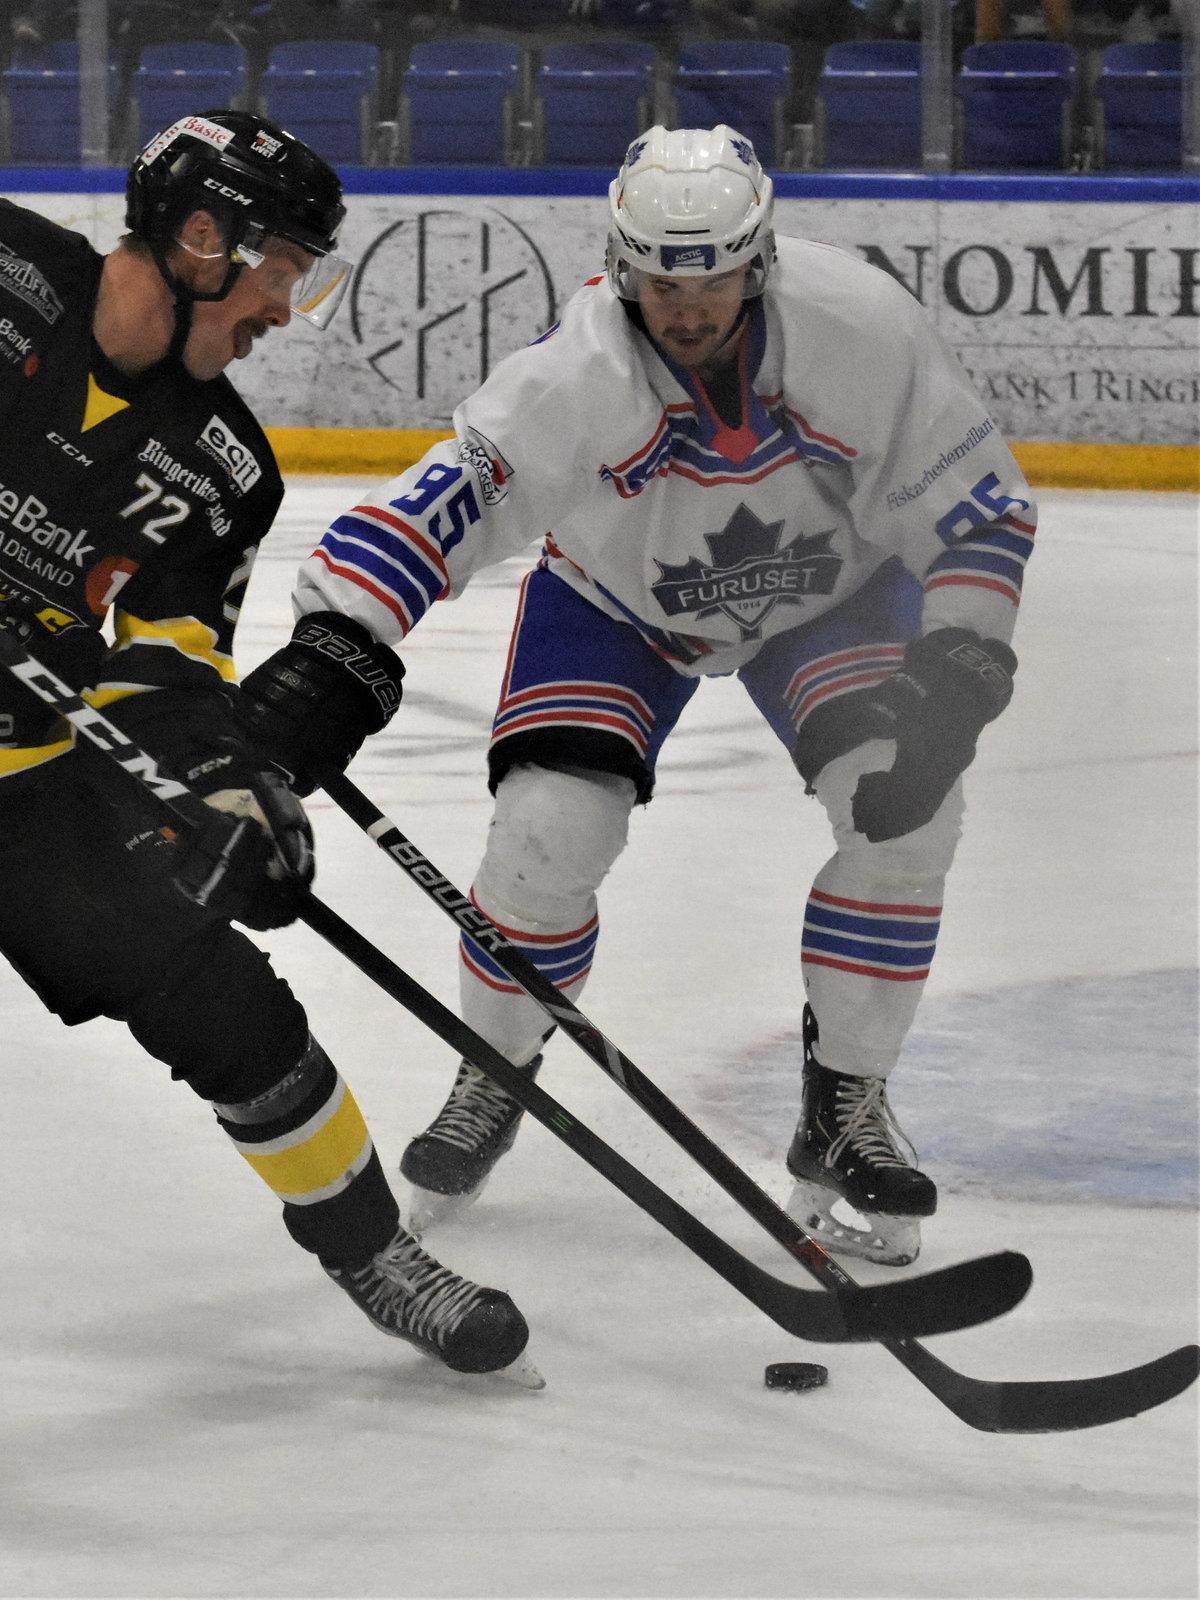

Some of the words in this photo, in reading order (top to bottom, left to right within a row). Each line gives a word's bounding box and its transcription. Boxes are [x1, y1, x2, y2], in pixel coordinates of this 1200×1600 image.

[184, 118, 226, 144] Basic
[203, 177, 253, 206] CCM
[46, 432, 94, 467] CCM
[886, 417, 994, 512] Fiskarhedenvillan
[119, 471, 191, 545] 72
[388, 462, 482, 559] 95
[677, 567, 818, 608] FURUSET
[9, 654, 191, 801] CCM
